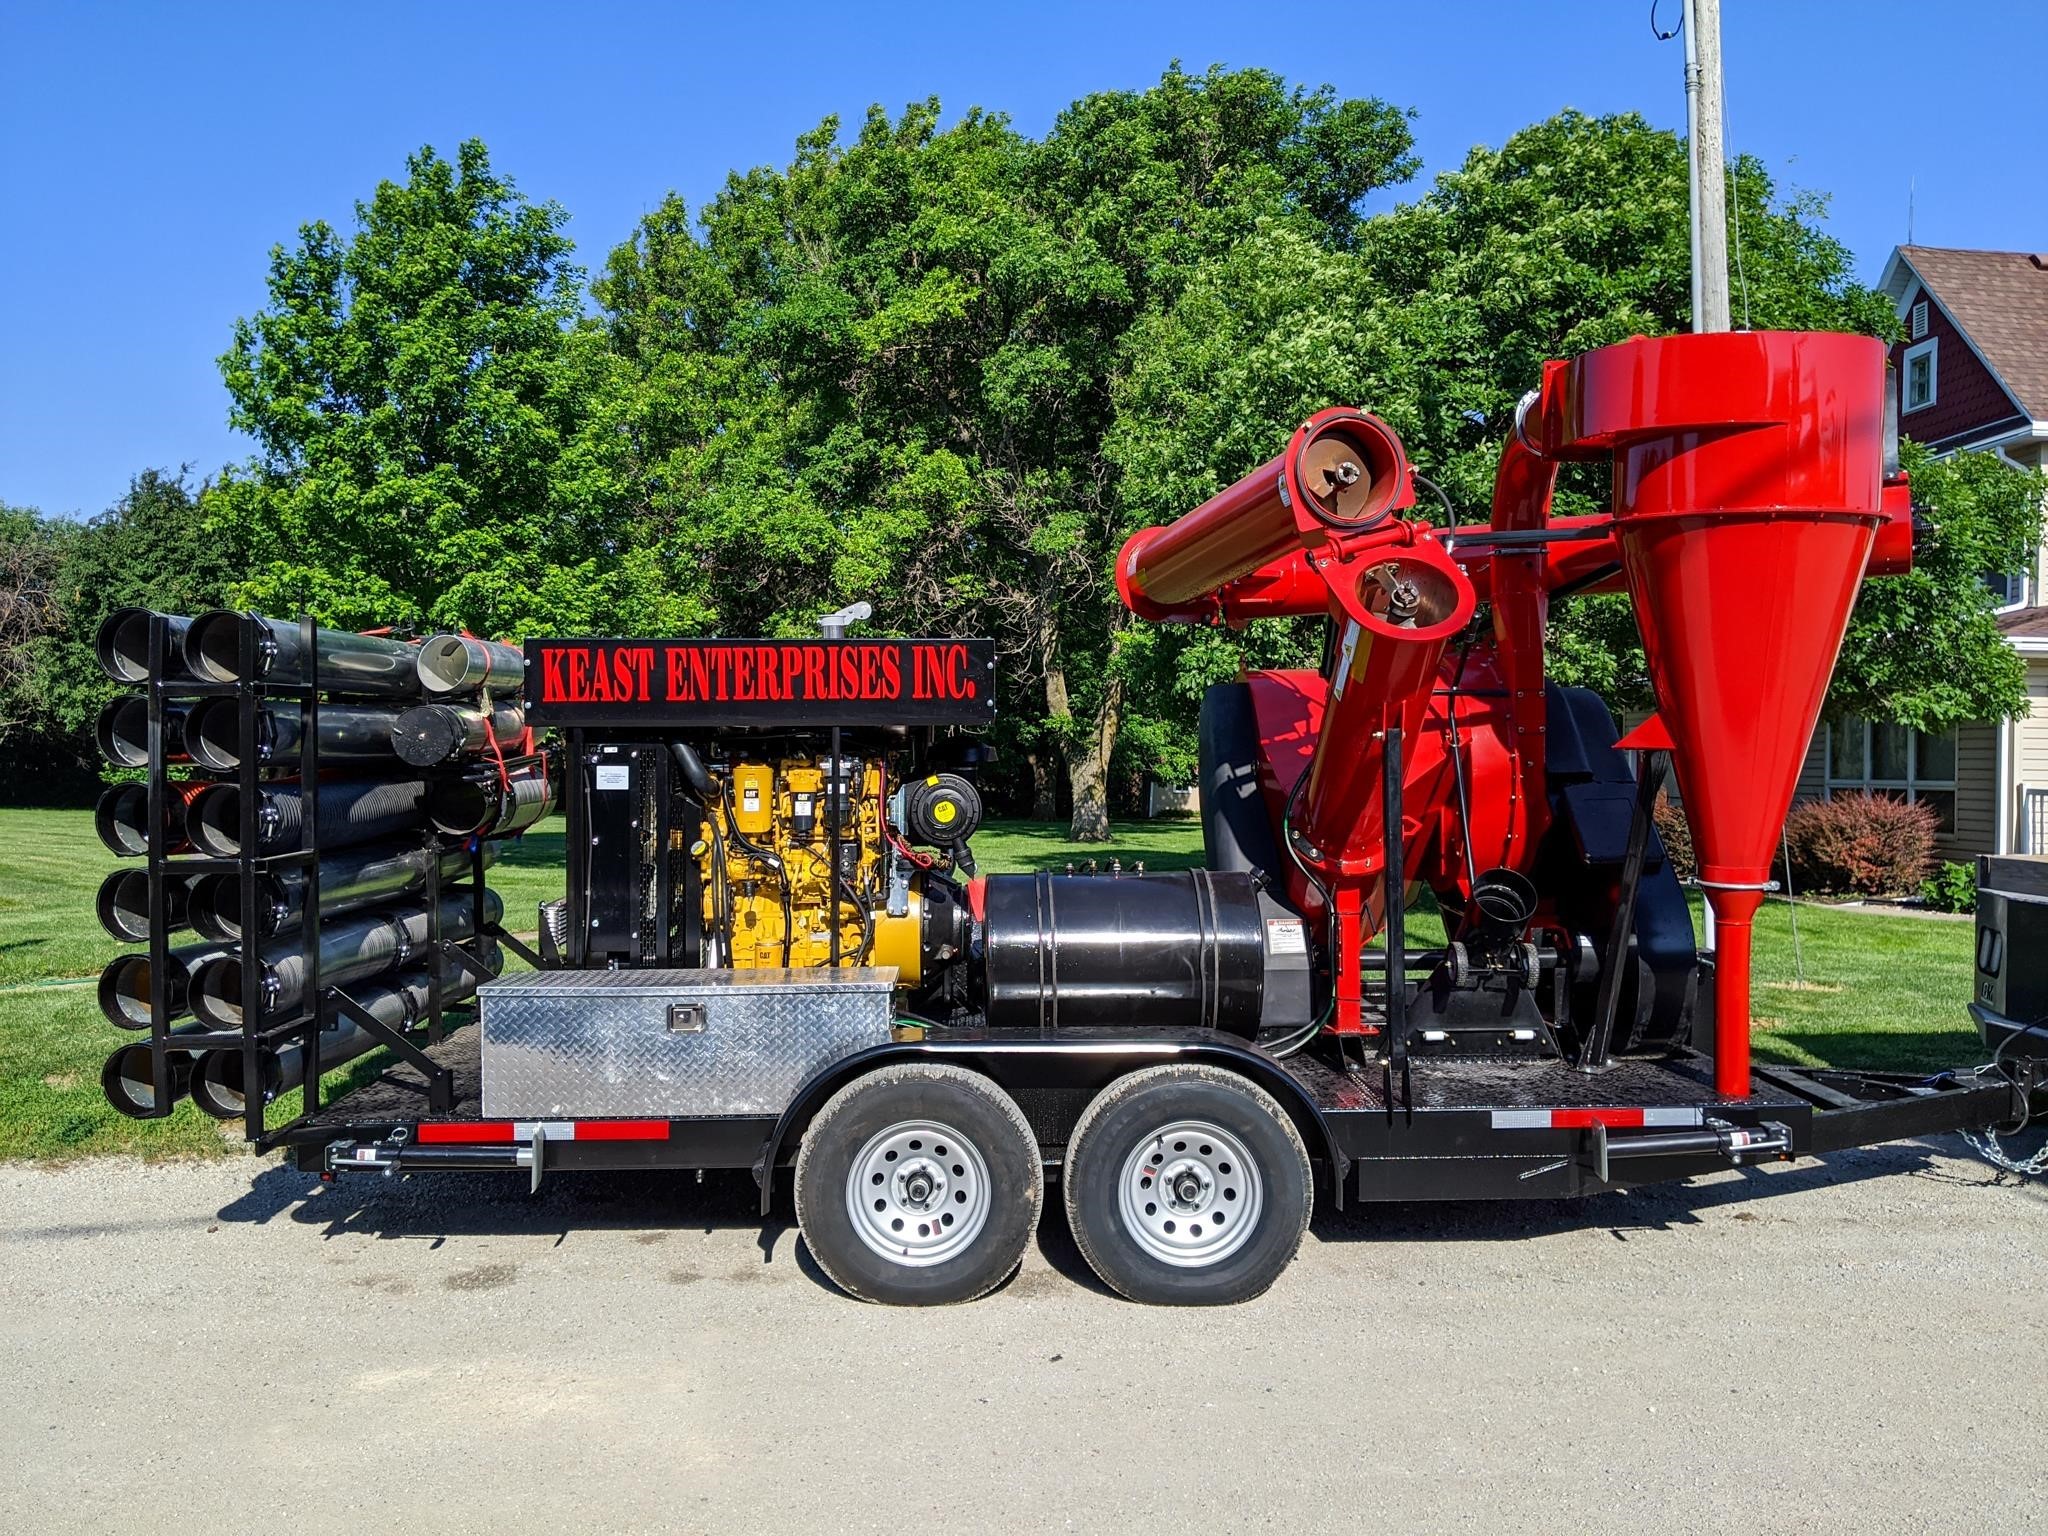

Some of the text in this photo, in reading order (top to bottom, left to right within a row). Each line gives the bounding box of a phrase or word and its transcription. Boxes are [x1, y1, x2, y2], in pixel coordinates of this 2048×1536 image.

[541, 644, 976, 703] KEAST ENTERPRISES INC.
[937, 804, 948, 813] CAT
[759, 951, 771, 959] CAT
